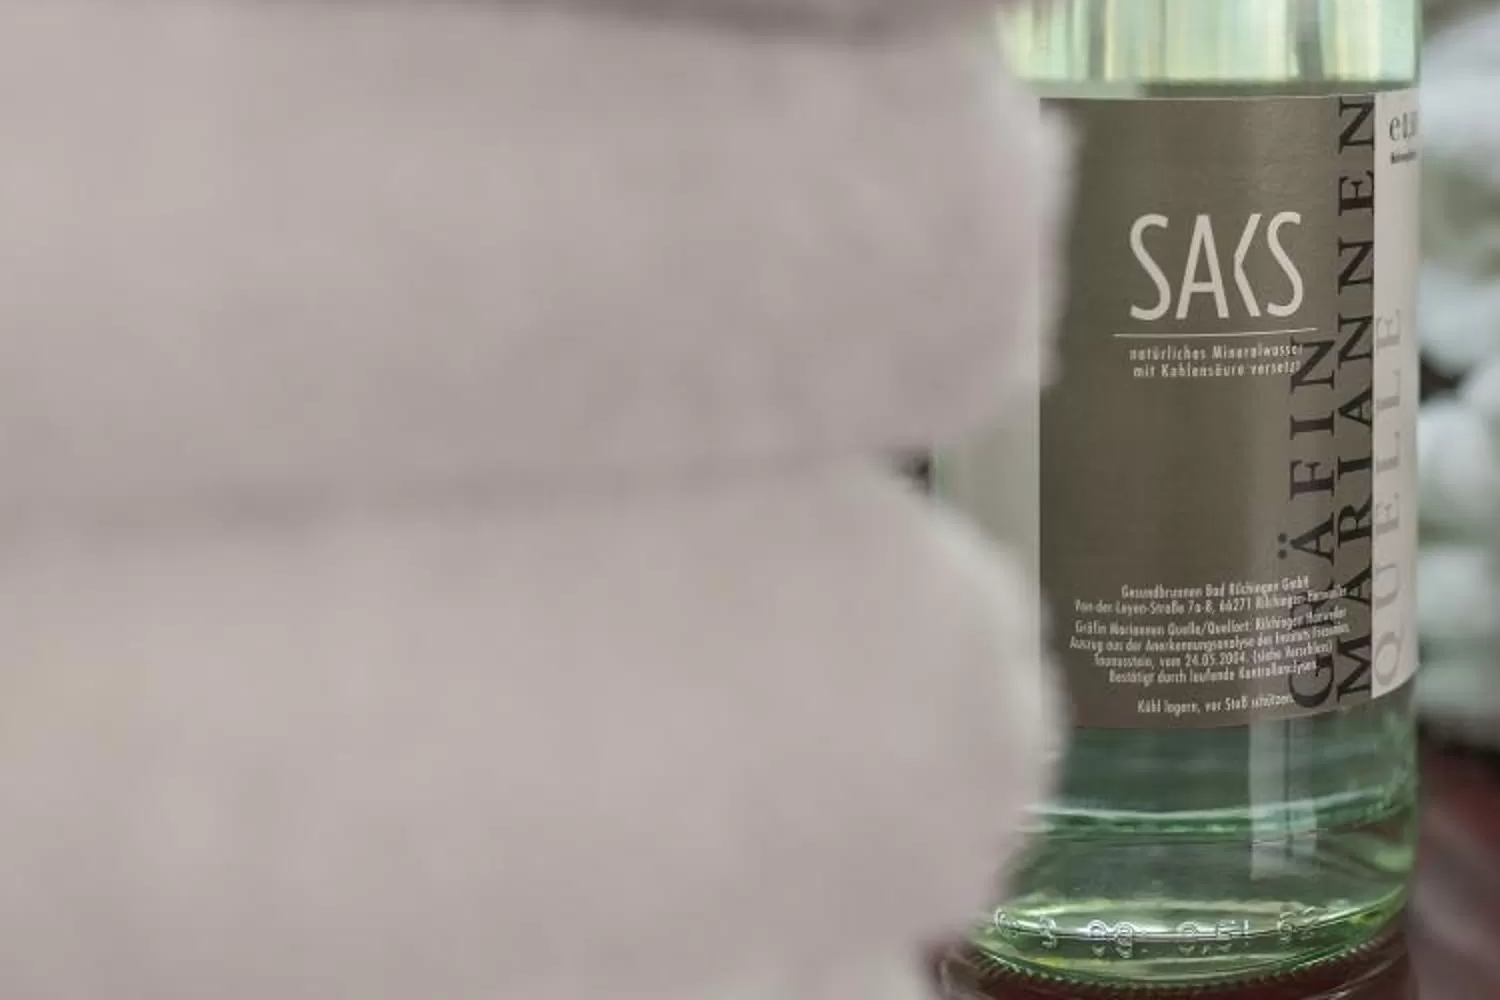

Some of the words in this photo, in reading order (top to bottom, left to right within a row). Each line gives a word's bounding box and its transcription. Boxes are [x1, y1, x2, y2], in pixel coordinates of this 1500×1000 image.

[1130, 211, 1303, 320] SAKS
[1133, 363, 1155, 377] mit
[1337, 94, 1375, 702] MARIANNEN
[1205, 583, 1225, 597] Bad
